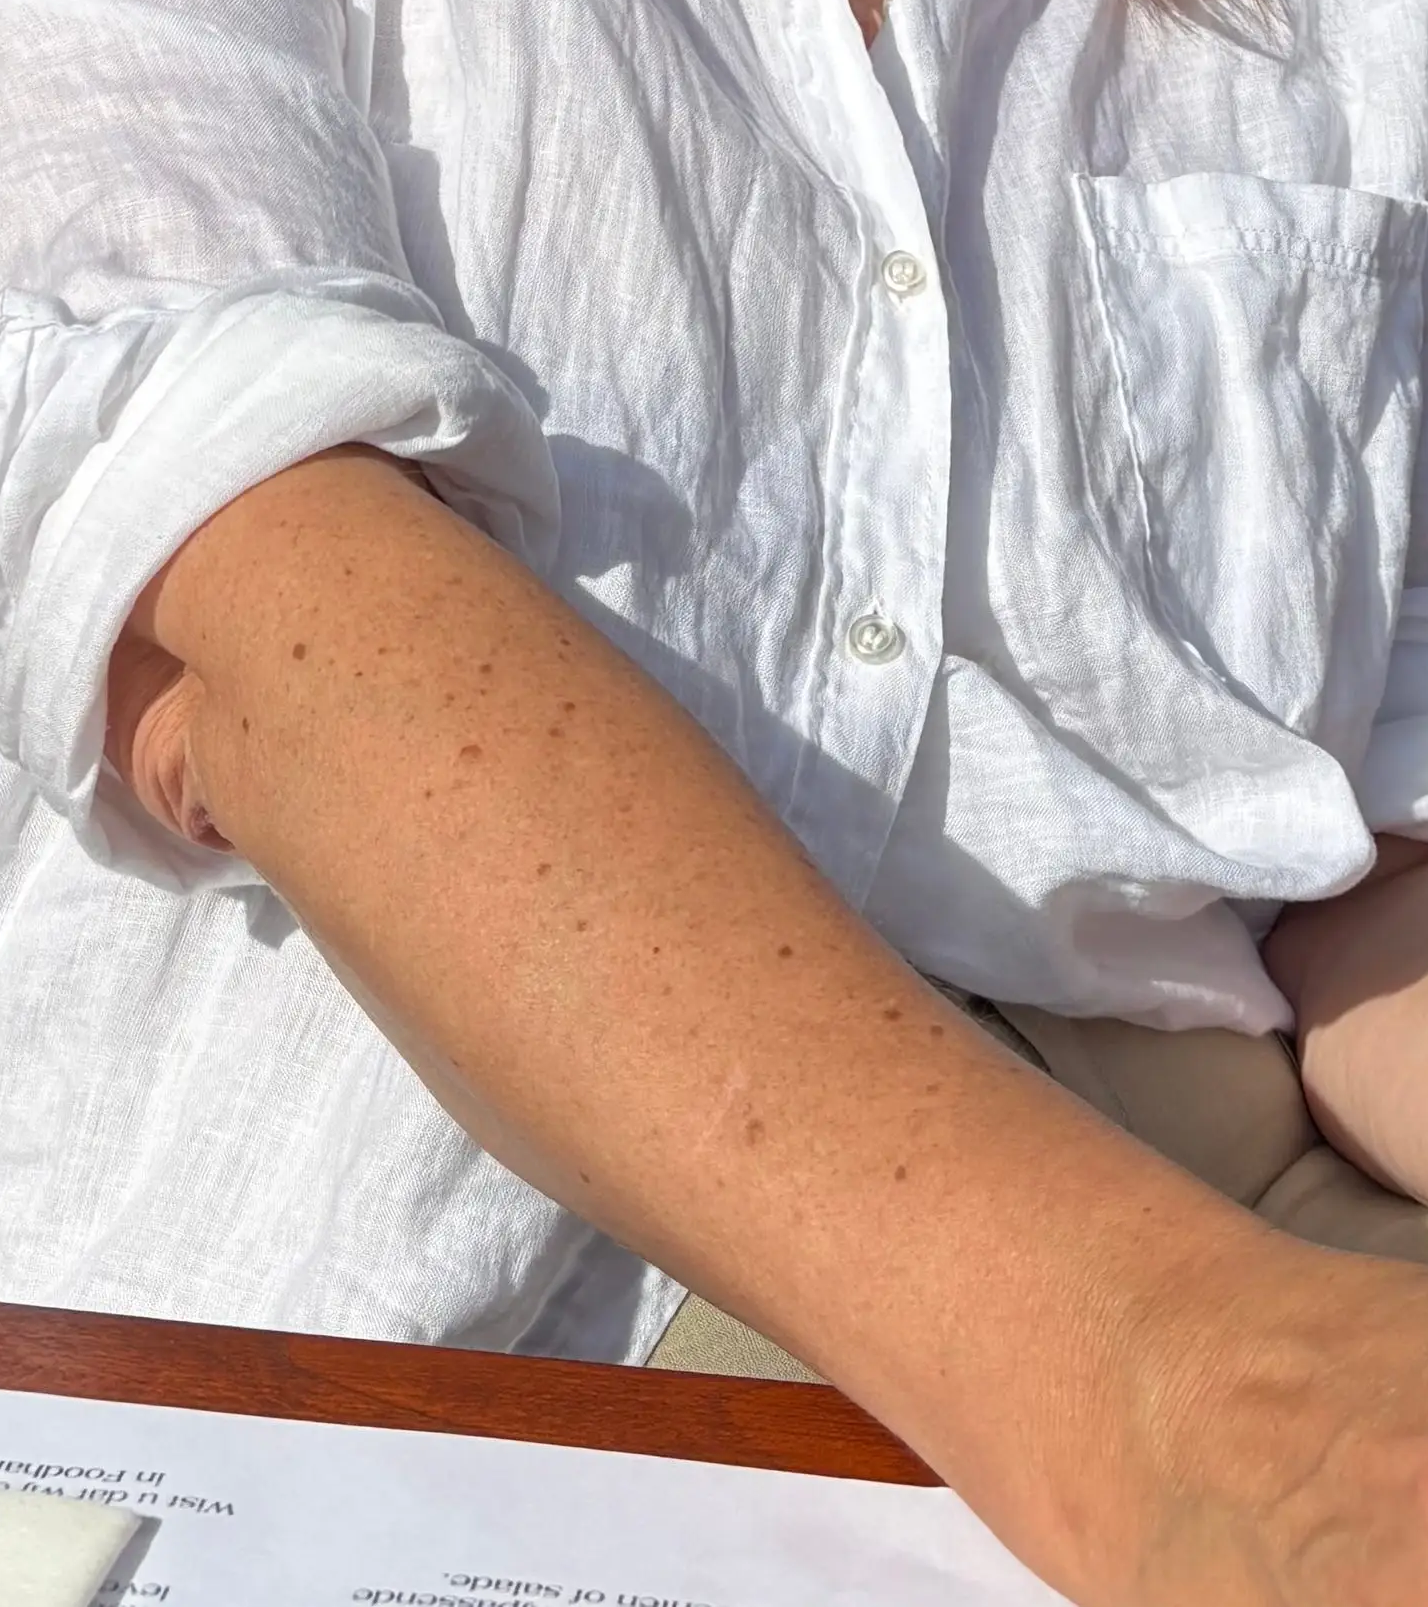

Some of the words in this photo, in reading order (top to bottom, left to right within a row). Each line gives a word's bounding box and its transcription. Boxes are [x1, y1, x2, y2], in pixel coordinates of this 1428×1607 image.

[135, 1470, 167, 1488] in
[138, 1492, 159, 1506] u
[166, 1495, 235, 1517] Wist
[98, 1580, 171, 1602] leve
[441, 1572, 563, 1599] salade.
[351, 1588, 534, 1607] passende
[568, 1589, 606, 1604] of
